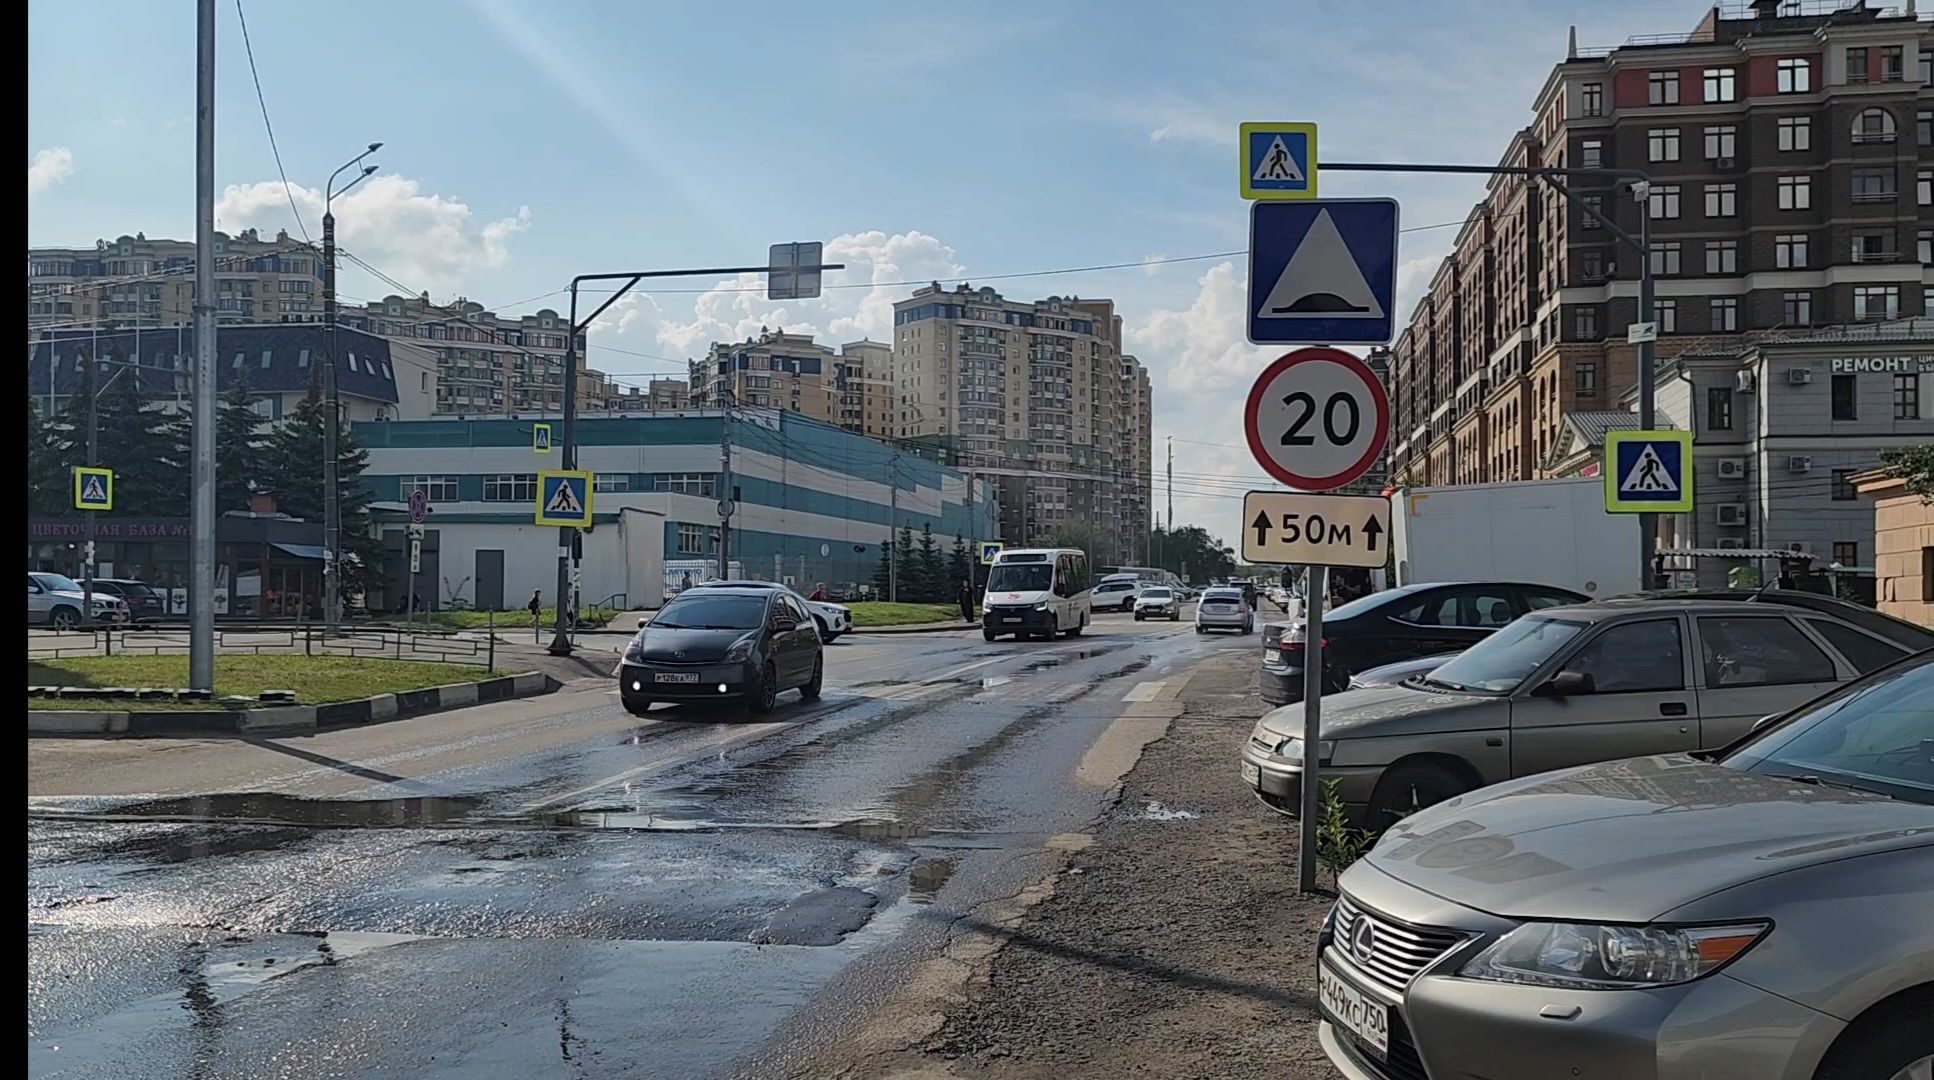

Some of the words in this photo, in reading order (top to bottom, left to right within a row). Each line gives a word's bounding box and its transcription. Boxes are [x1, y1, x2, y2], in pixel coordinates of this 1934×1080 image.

[1831, 357, 1911, 372] РЕМОНТ
[1280, 391, 1360, 446] 20
[128, 524, 166, 536] БАЗА
[1361, 1000, 1385, 1034] 750
